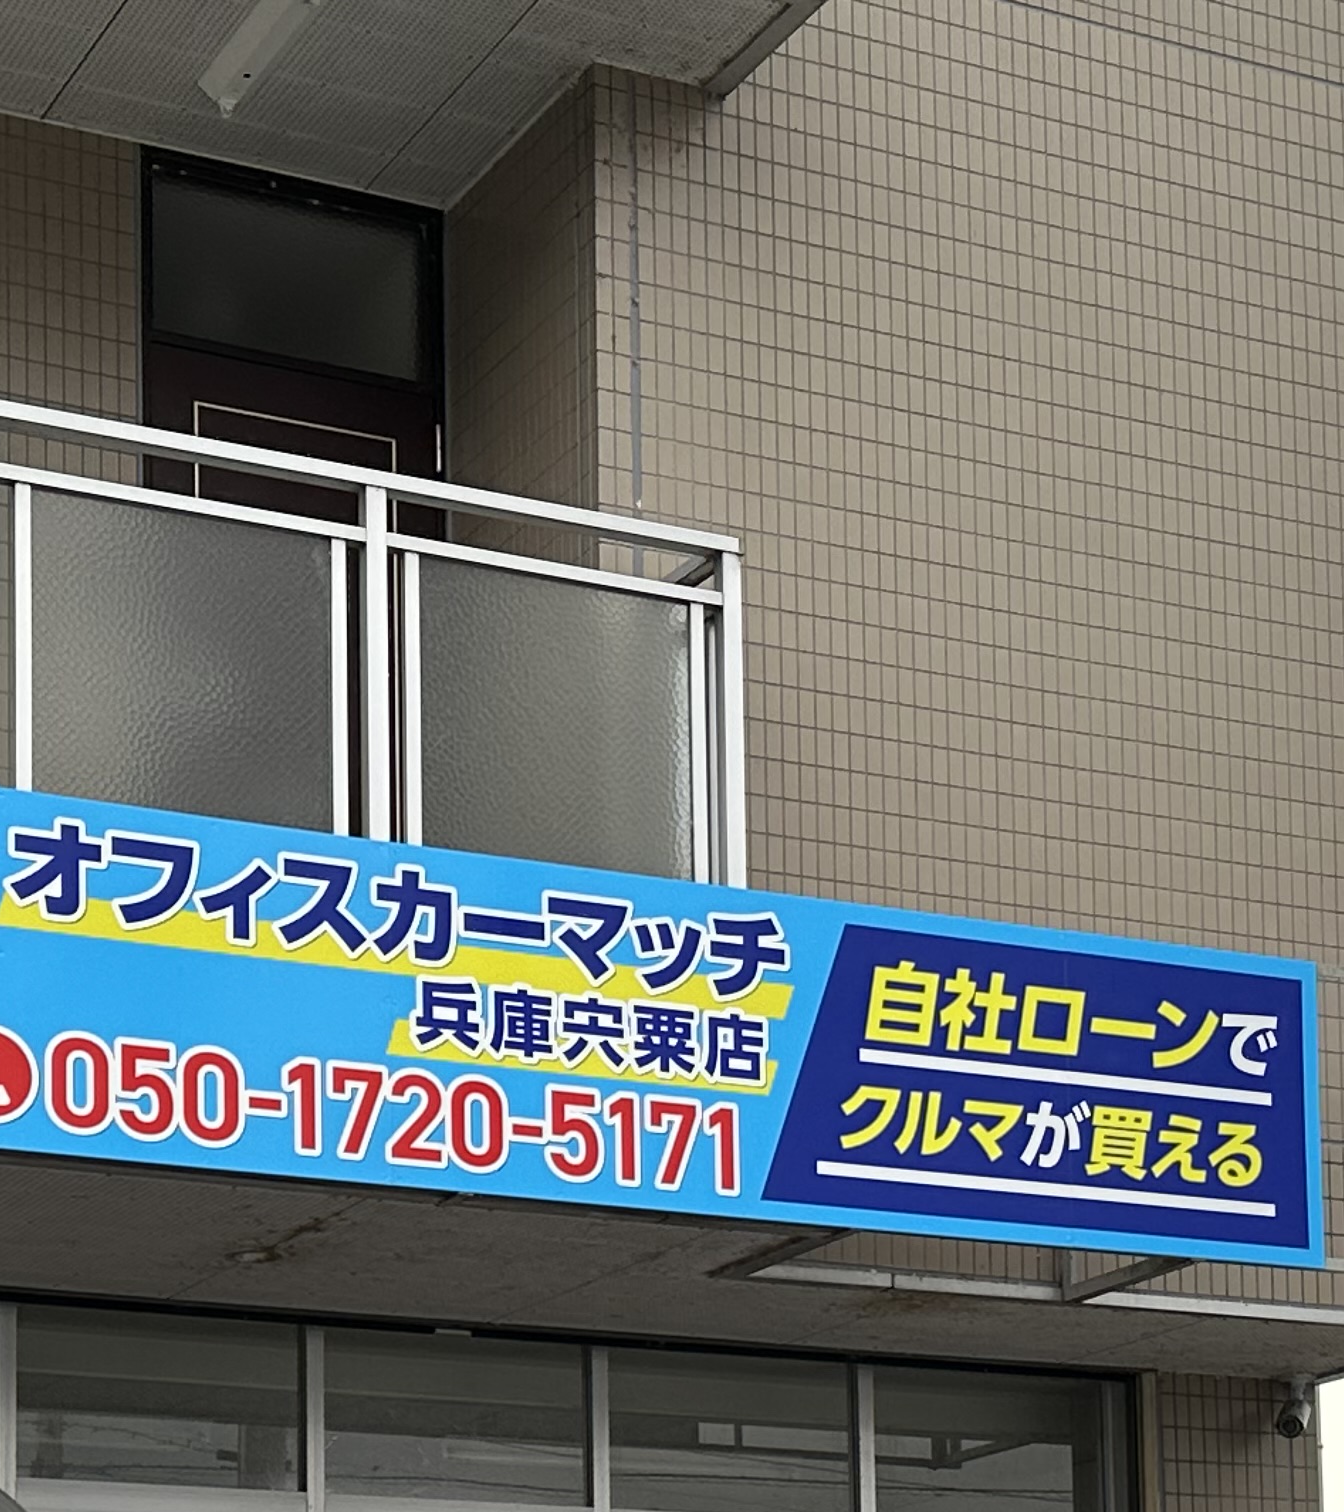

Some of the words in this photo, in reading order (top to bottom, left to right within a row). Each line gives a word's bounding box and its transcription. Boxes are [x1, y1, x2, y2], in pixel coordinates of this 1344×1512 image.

[8, 823, 786, 997] オフィスカーマッチ
[416, 979, 765, 1081] 兵庫宍粟店
[864, 960, 1278, 1077] 自社ローンで
[51, 1037, 735, 1191] 050-1720-5171
[840, 1085, 1264, 1187] クルマが買える
